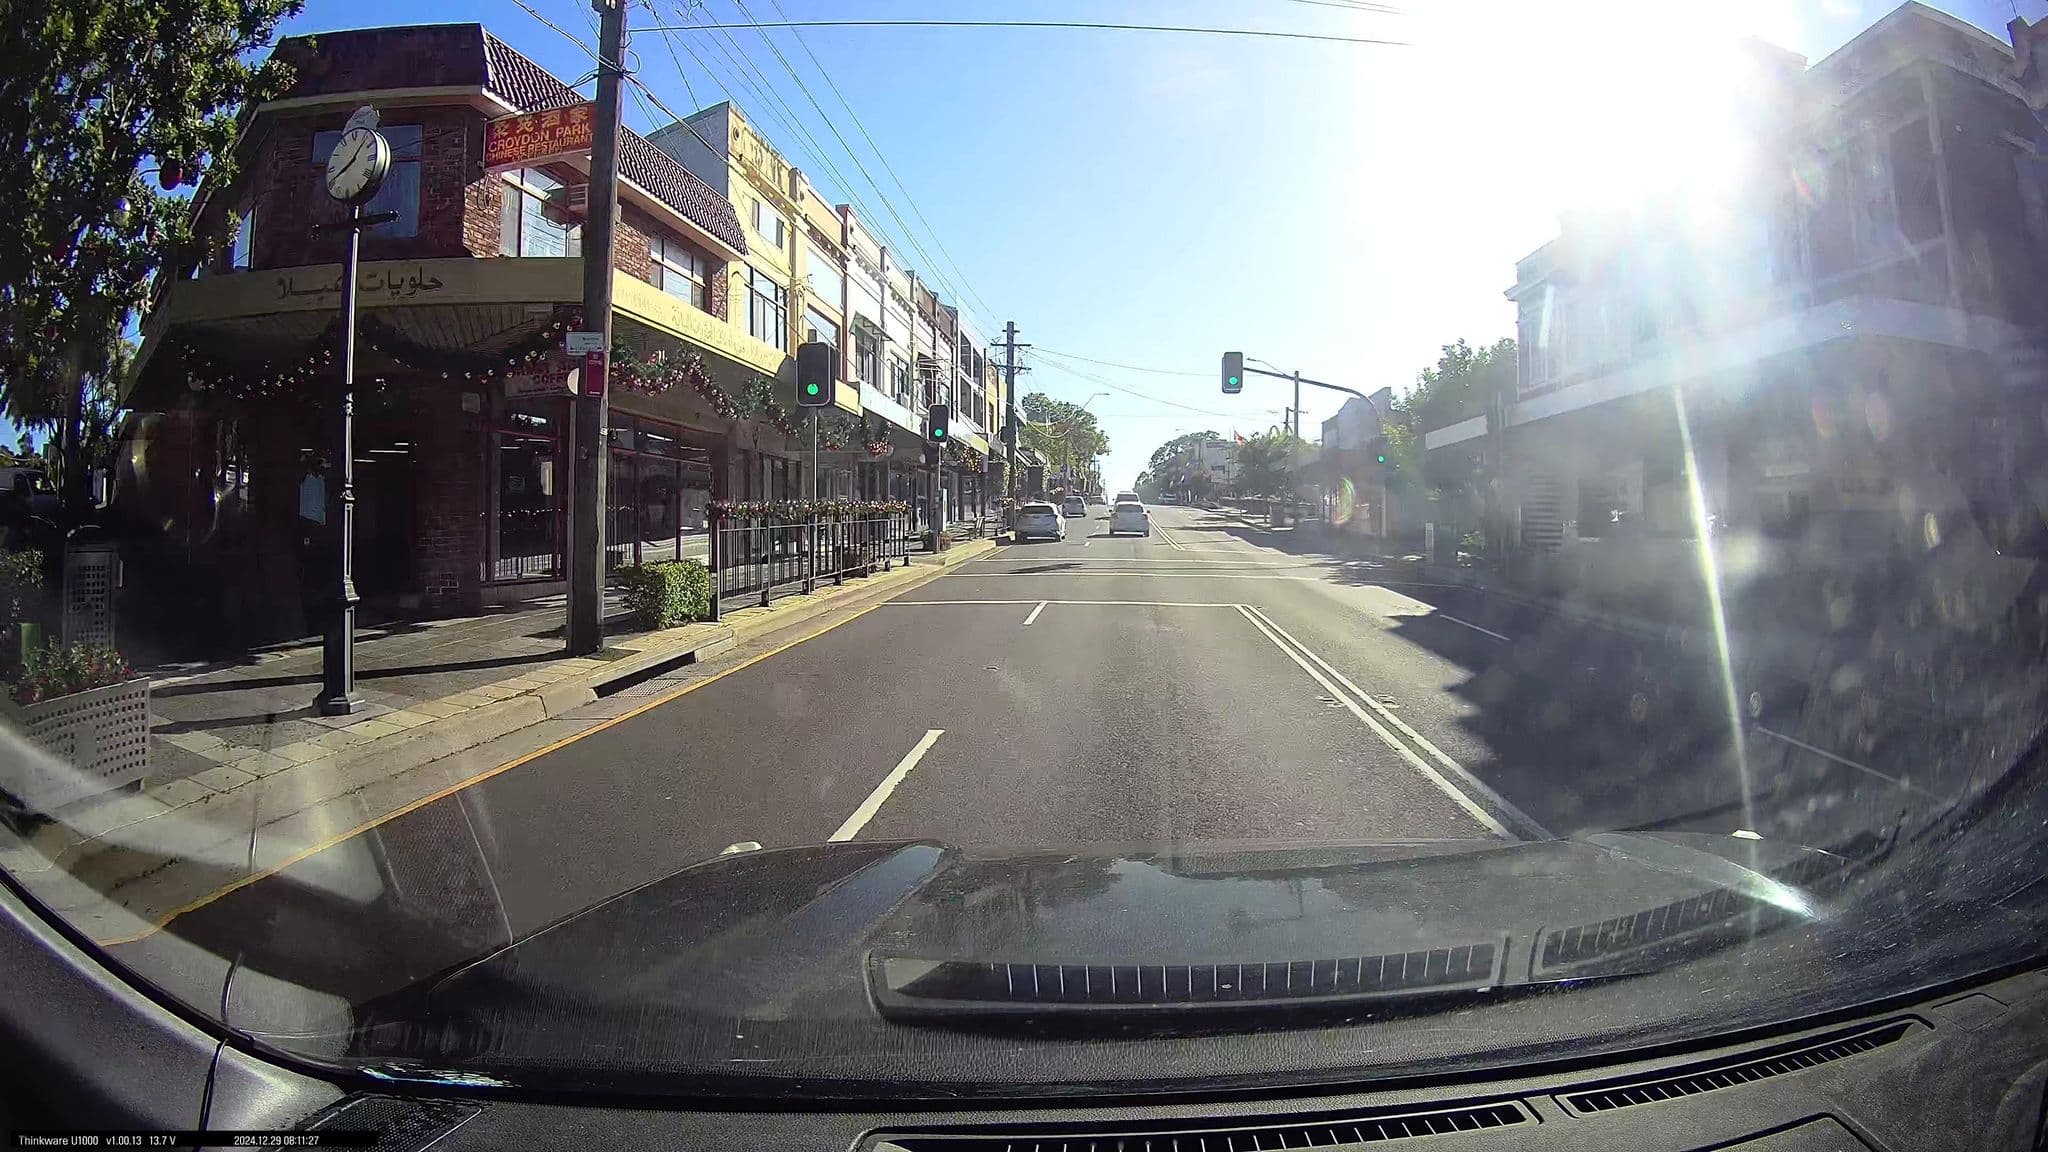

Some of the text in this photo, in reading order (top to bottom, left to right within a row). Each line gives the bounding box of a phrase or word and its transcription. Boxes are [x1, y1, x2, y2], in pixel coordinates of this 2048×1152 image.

[485, 132, 594, 162] CHINESE RESTAURANT
[488, 122, 591, 153] CROYDON PARK
[359, 267, 443, 296] حلويات
